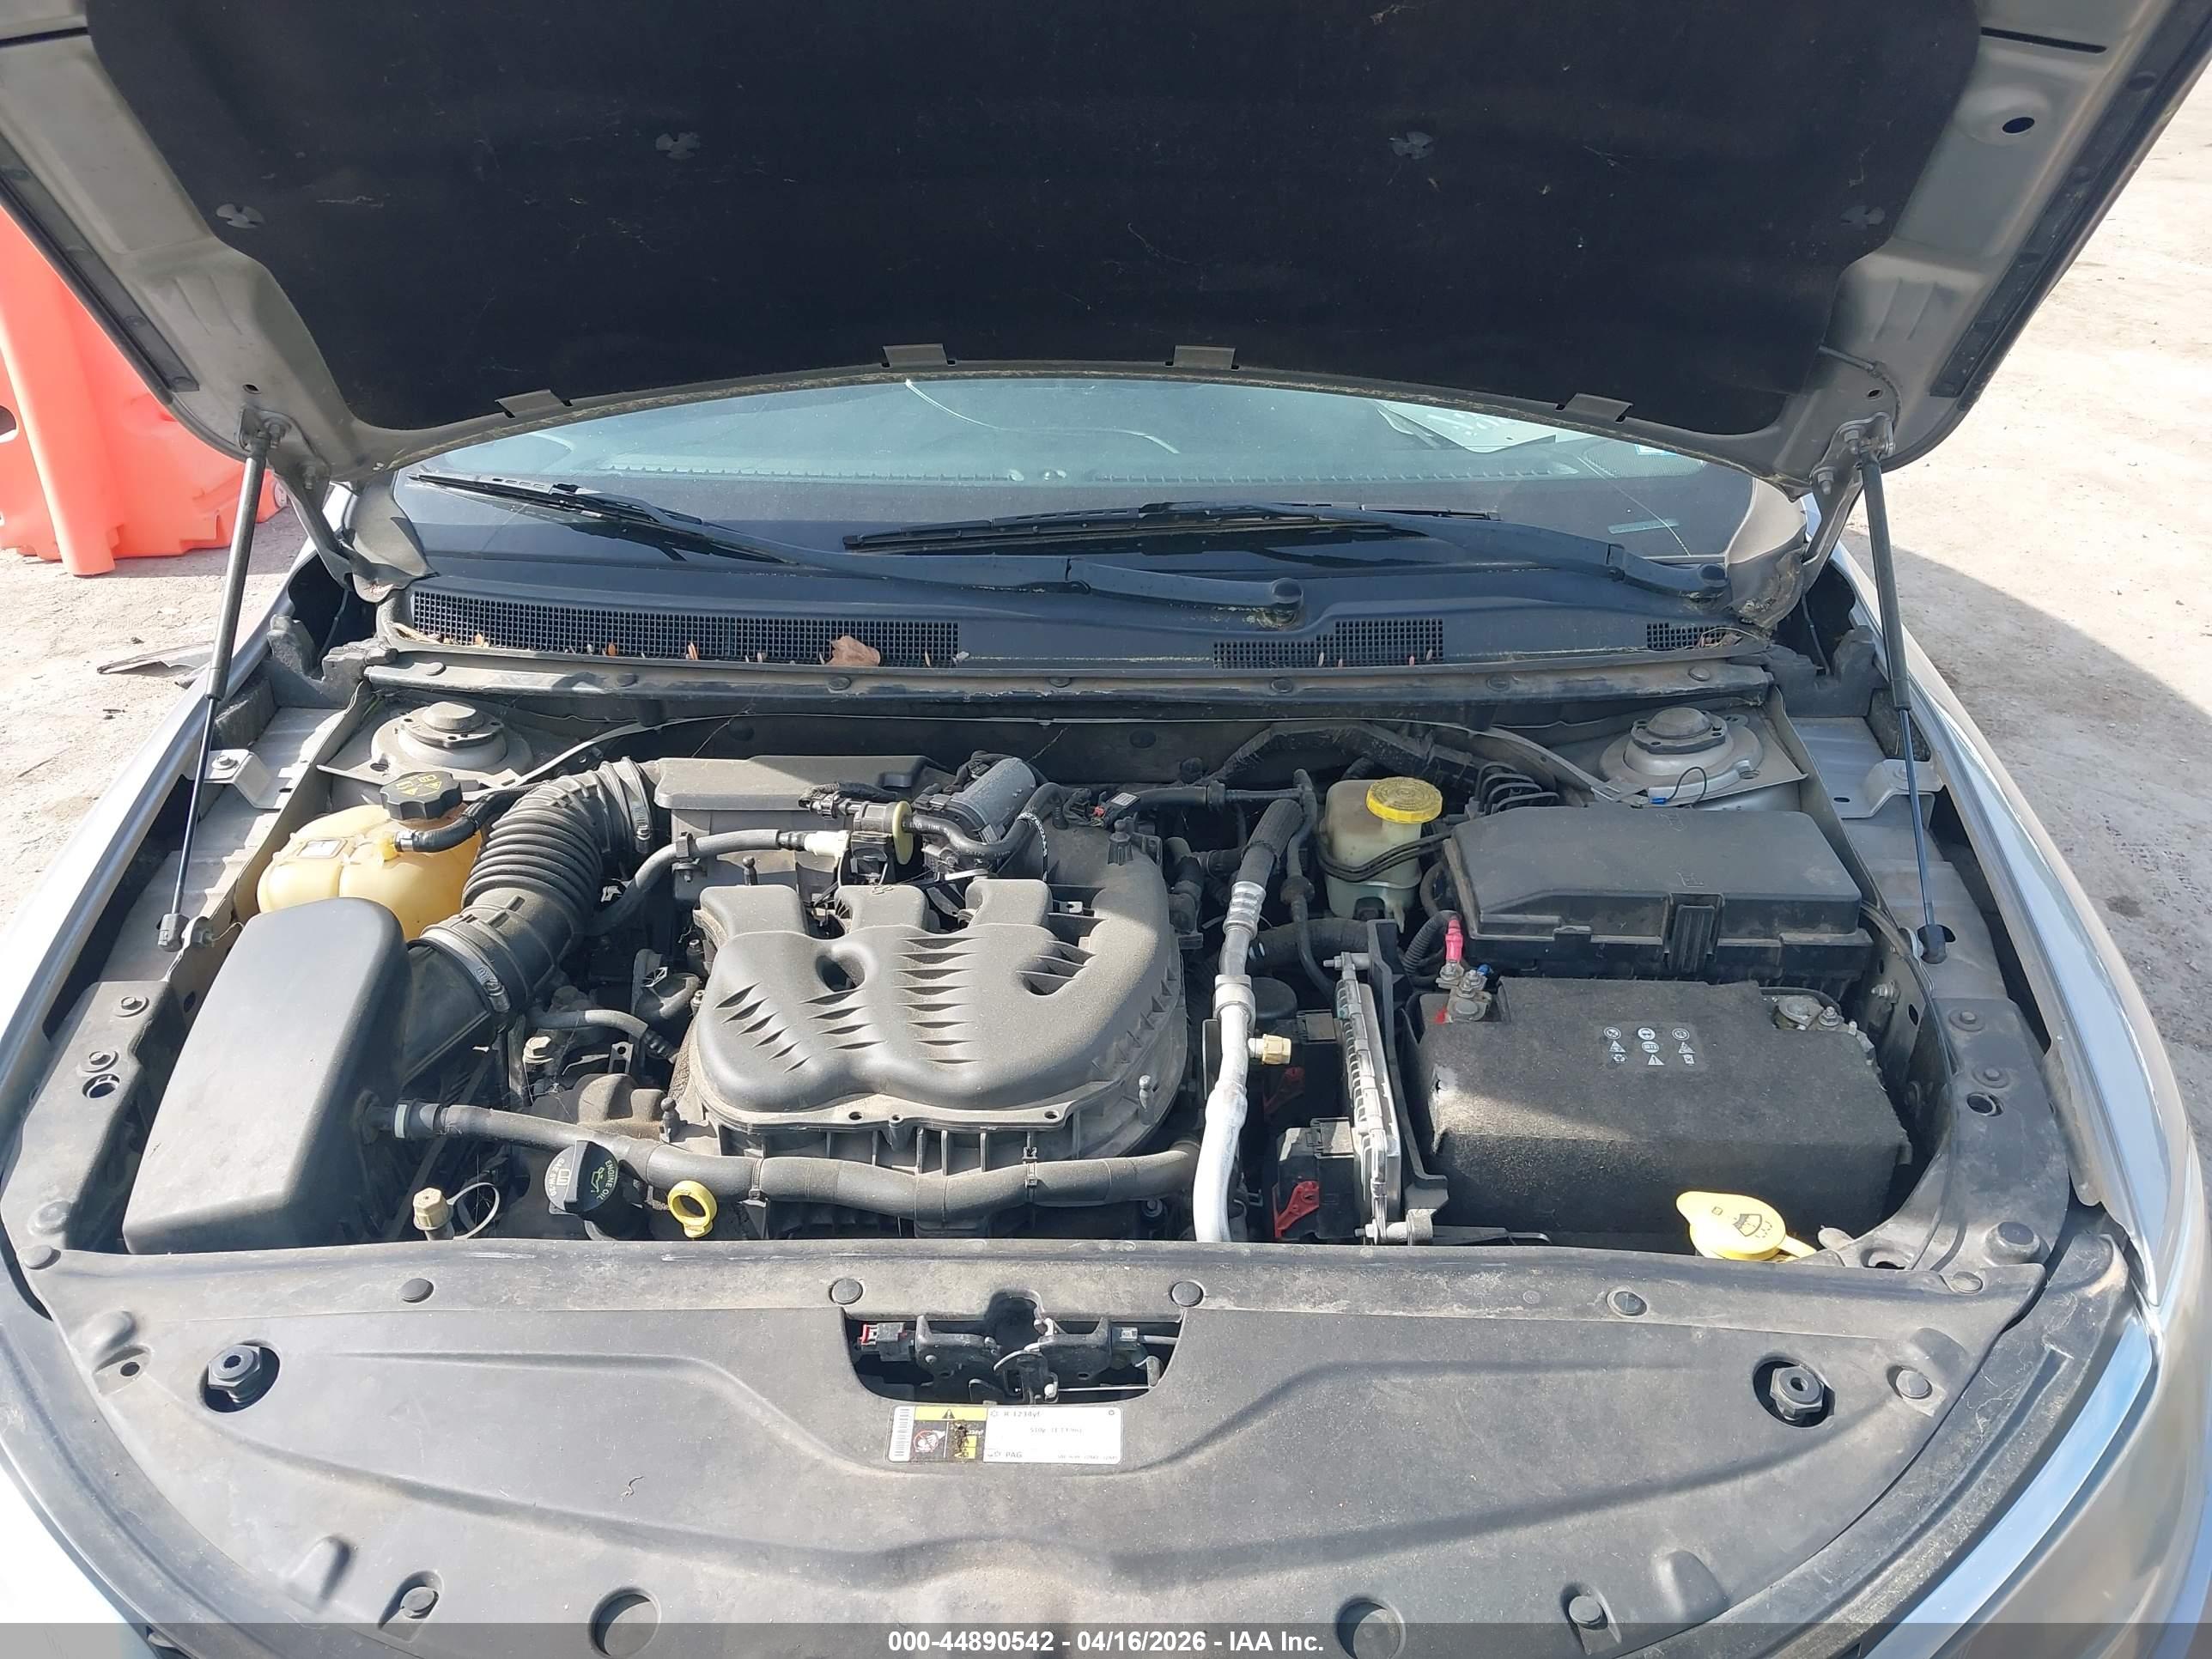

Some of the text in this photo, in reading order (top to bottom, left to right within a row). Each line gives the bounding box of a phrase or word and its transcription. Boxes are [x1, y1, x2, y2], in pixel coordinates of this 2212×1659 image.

[551, 1158, 565, 1172] SAE
[596, 1159, 616, 1201] ENGINE OIL
